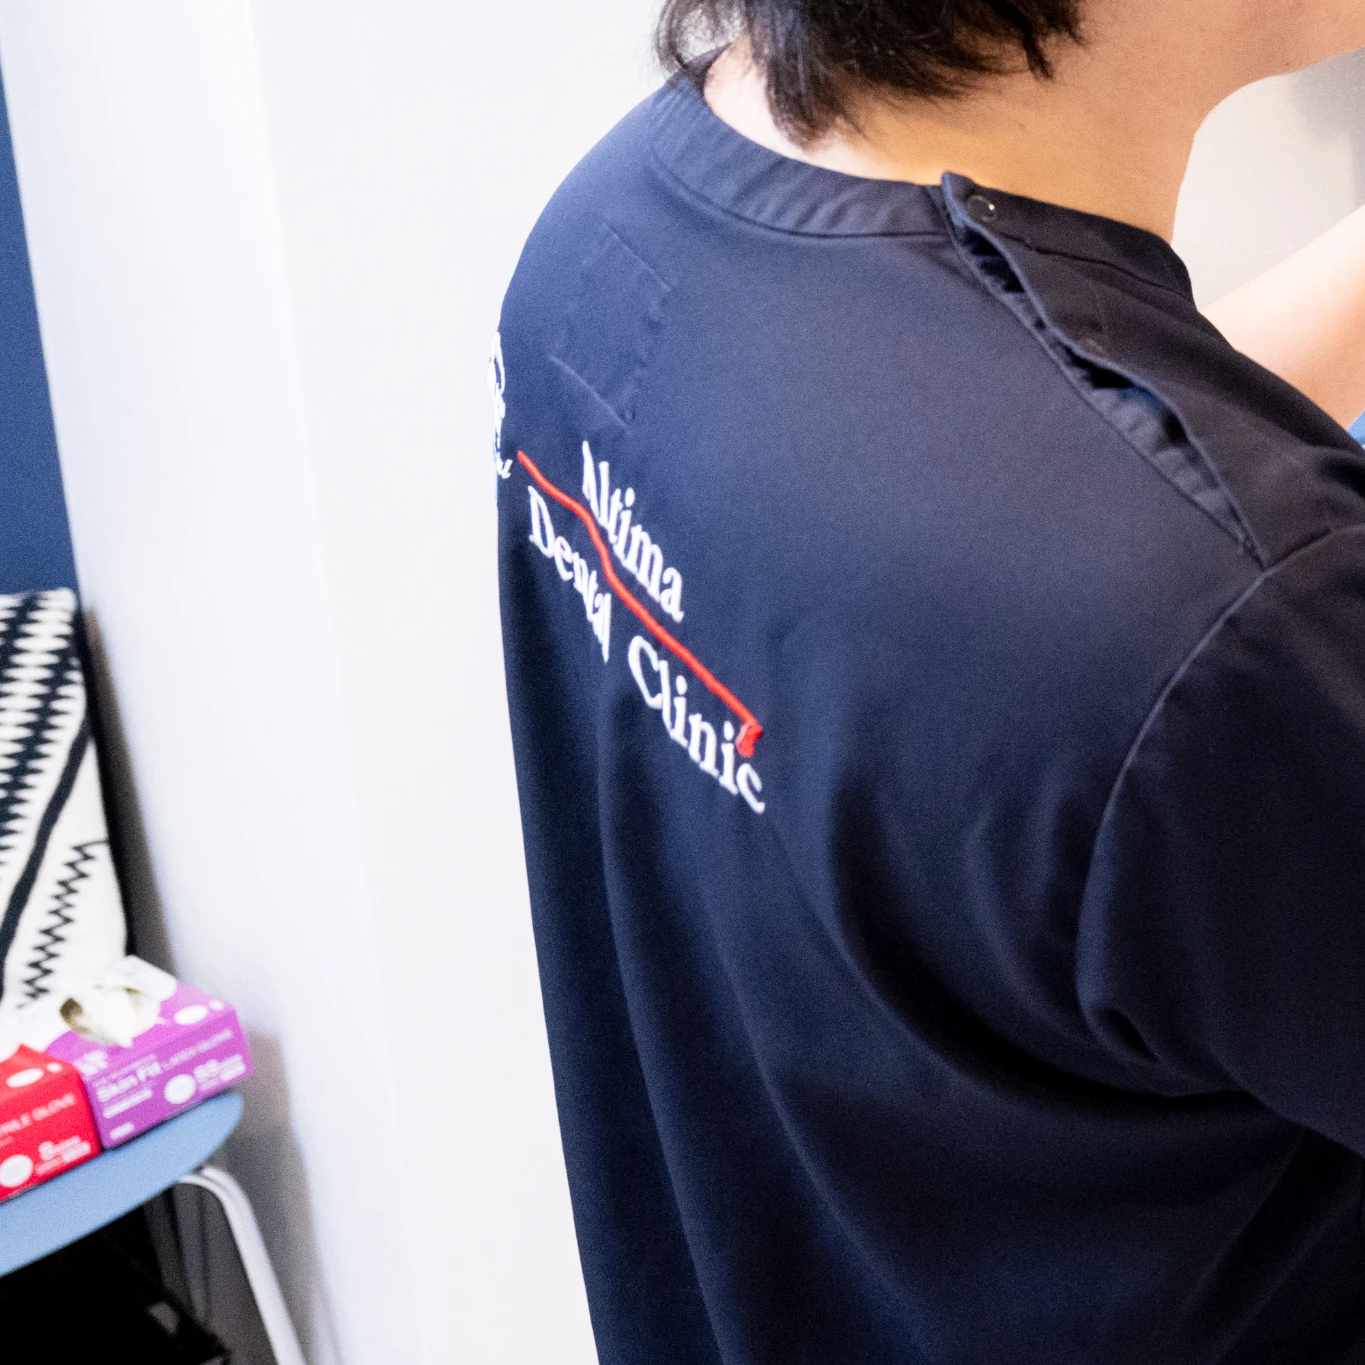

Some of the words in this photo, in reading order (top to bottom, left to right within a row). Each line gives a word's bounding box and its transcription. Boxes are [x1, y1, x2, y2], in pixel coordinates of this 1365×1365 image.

[582, 440, 684, 622] Altima
[528, 485, 611, 663] Dental
[628, 635, 766, 814] Clinic
[32, 1093, 76, 1121] GLOVE
